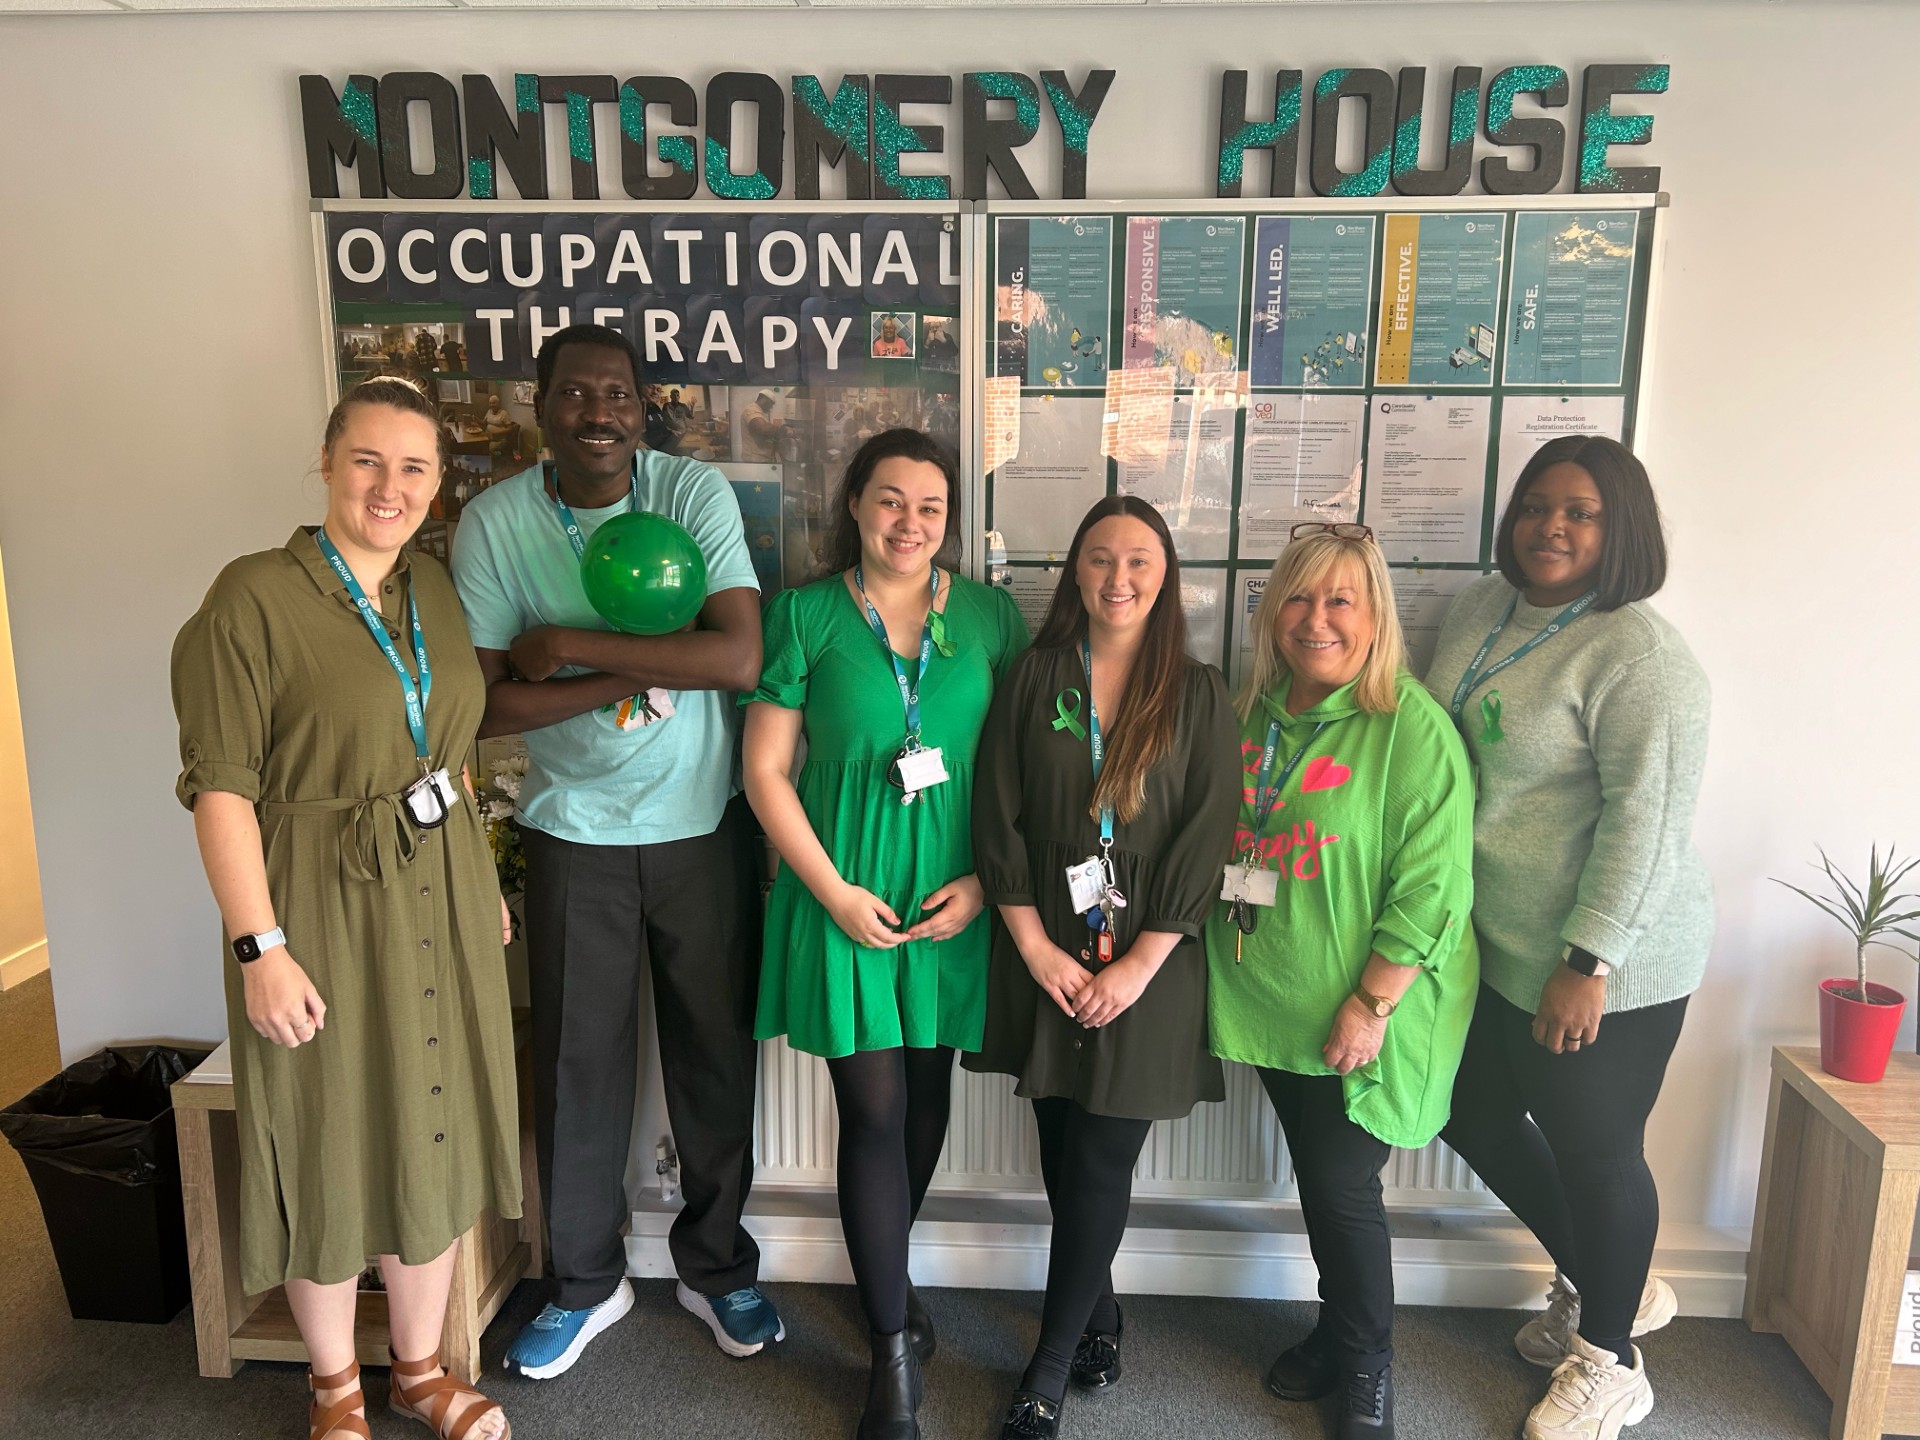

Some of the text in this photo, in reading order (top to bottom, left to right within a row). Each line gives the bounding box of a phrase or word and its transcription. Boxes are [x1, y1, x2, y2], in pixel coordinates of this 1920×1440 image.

[300, 64, 1670, 200] MONTGOMERY HOUSE
[337, 228, 961, 288] OCCUPATIONAL
[1140, 226, 1155, 333] RESPONSIVE.
[1266, 244, 1284, 333] WELL LED.
[1395, 242, 1412, 331] EFFECTIVE.
[1011, 266, 1024, 333] CARING.
[1523, 284, 1539, 330] SAFE.
[1516, 317, 1522, 327] we
[1565, 423, 1598, 431] Certificate
[331, 555, 352, 582] PROUD
[1572, 591, 1598, 613] PROUD
[366, 607, 380, 629] Northern
[385, 645, 405, 673] PROUD
[418, 647, 429, 674] PROUD
[921, 640, 930, 663] PROUD
[1471, 647, 1488, 670] PROUD
[1488, 655, 1515, 673] PROUD
[413, 703, 421, 727] Northern
[1094, 733, 1102, 760] PROUD
[1263, 745, 1275, 771] PROUD
